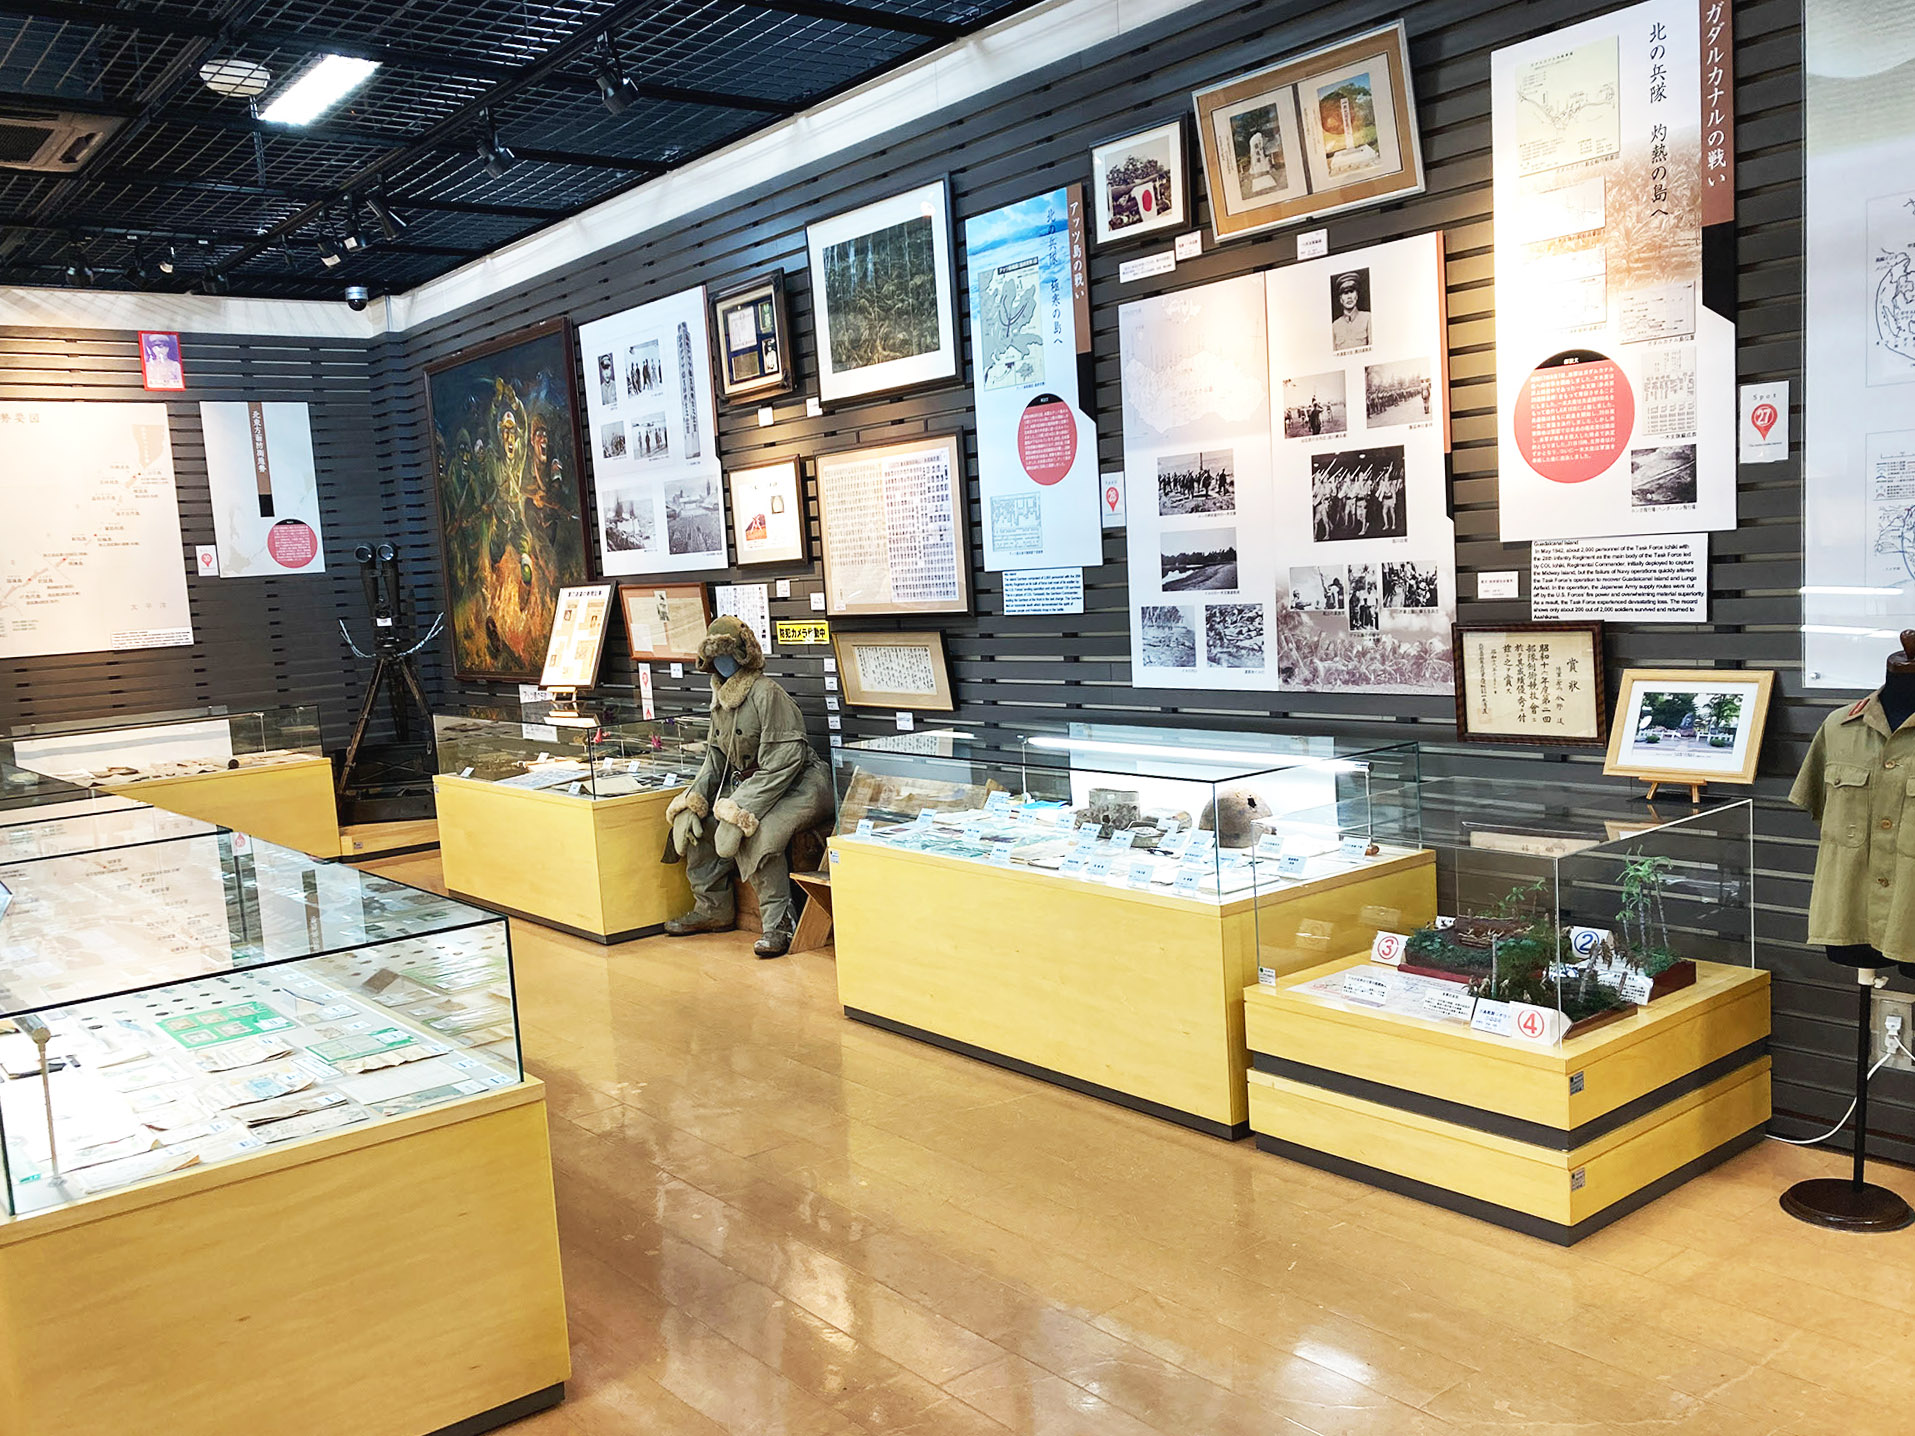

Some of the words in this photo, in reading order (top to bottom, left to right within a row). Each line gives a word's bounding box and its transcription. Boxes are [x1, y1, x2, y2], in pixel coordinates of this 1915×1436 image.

[1650, 22, 1667, 104] 北の兵隊
[1706, 1, 1726, 187] ガダルカナルの戦い
[1650, 123, 1668, 217] 灼熱の島へ
[1070, 201, 1084, 299] アッツ島の戦い
[1756, 408, 1772, 426] 27
